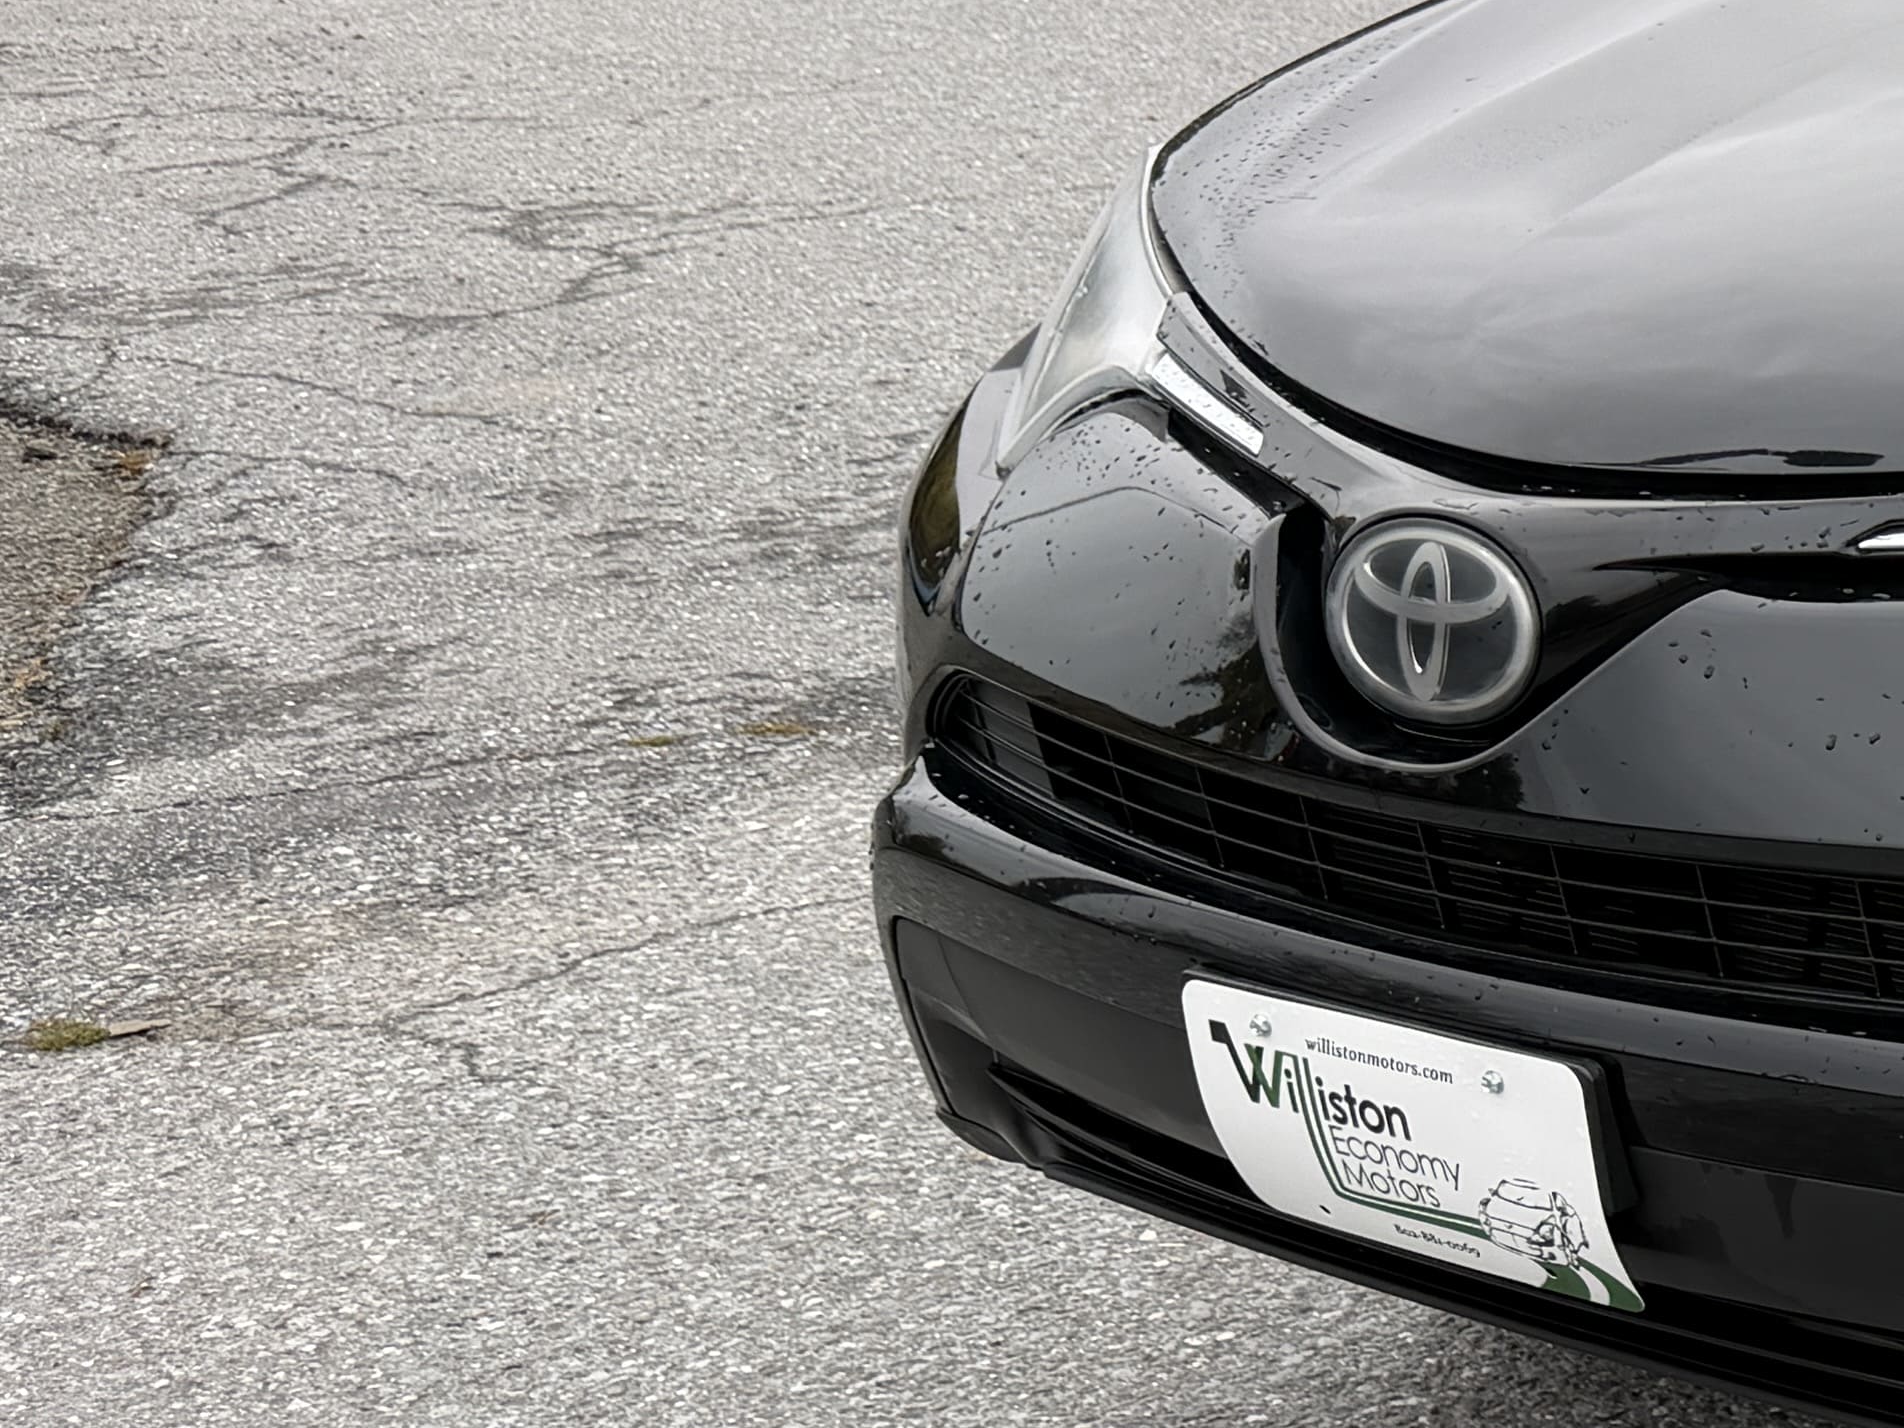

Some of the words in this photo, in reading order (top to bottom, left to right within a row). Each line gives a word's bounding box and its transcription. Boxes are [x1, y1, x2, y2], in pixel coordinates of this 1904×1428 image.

[1209, 1019, 1412, 1141] Williston
[1304, 1037, 1454, 1085] willistonmotors.com
[1328, 1125, 1461, 1191] Economy
[1342, 1160, 1442, 1208] Motors
